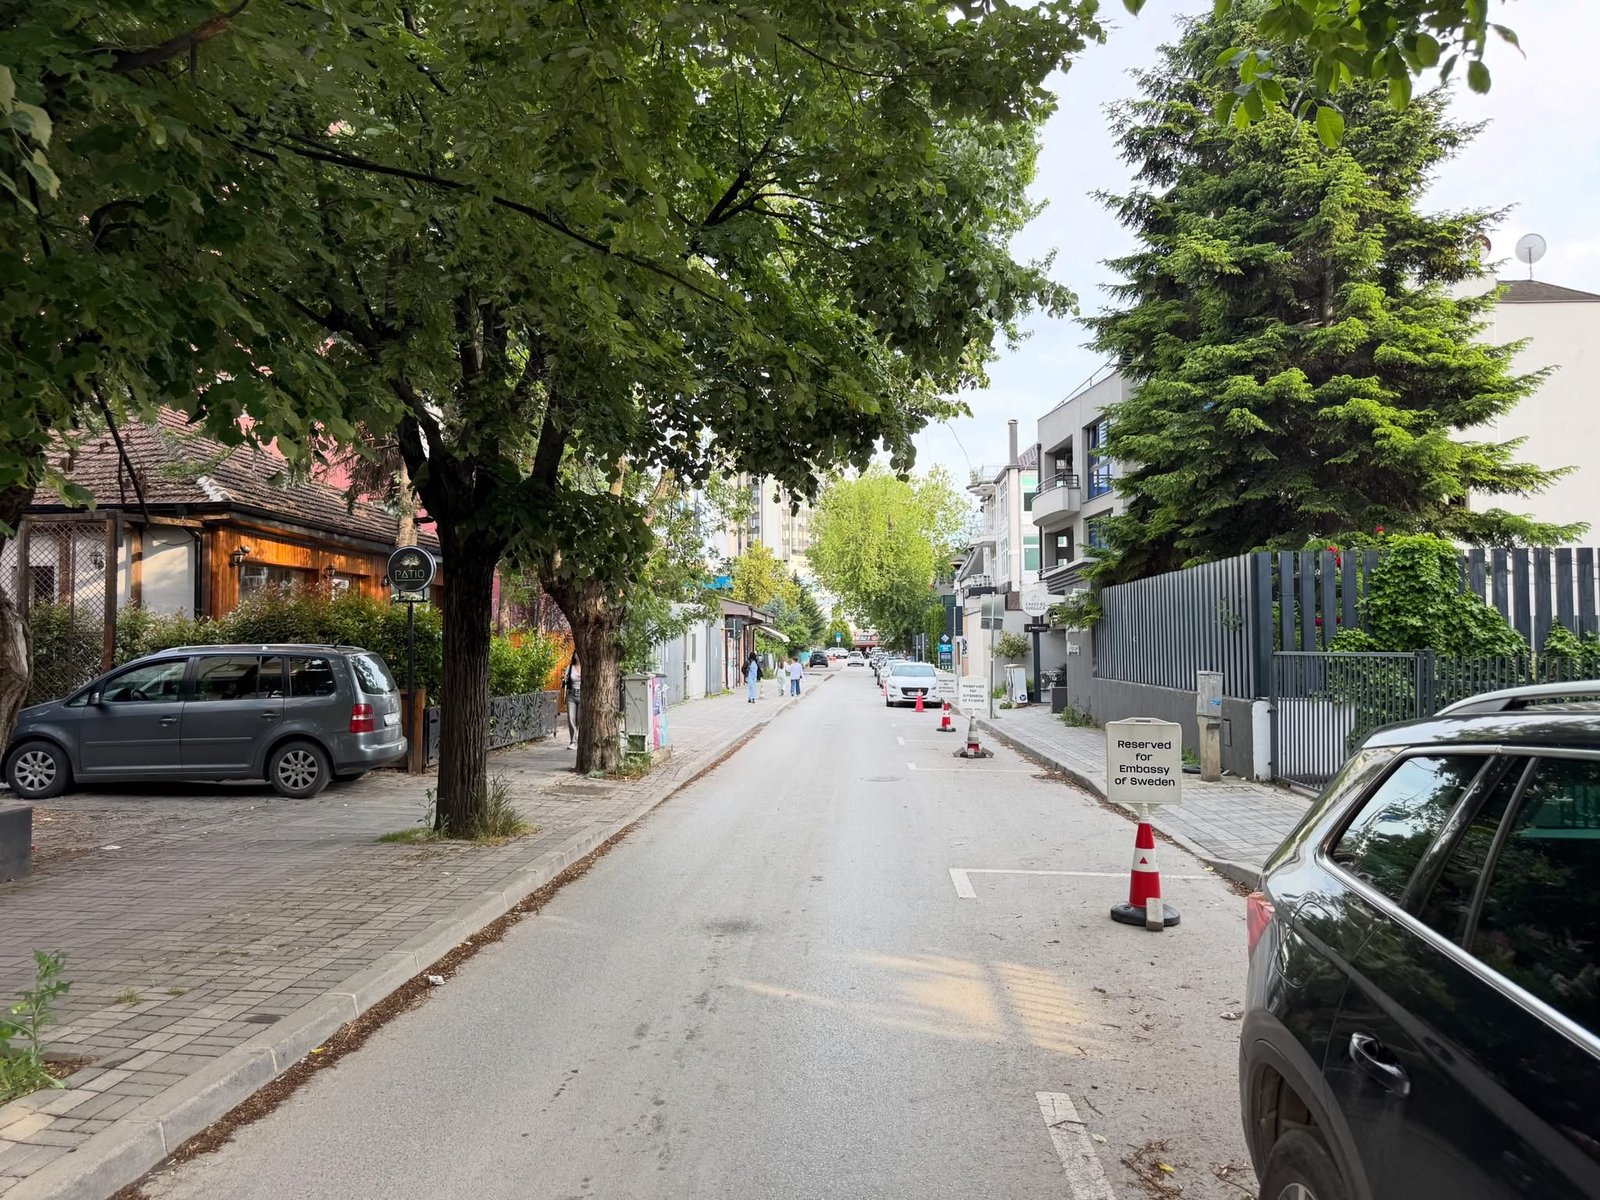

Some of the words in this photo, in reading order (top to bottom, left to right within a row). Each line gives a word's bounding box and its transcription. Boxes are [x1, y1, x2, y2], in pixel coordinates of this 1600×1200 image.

[394, 569, 425, 580] PATIO
[1117, 740, 1172, 750] Reserved
[1135, 752, 1153, 762] for
[1119, 764, 1170, 776] Embassy
[1114, 776, 1127, 786] of
[1130, 777, 1176, 787] Sweden
